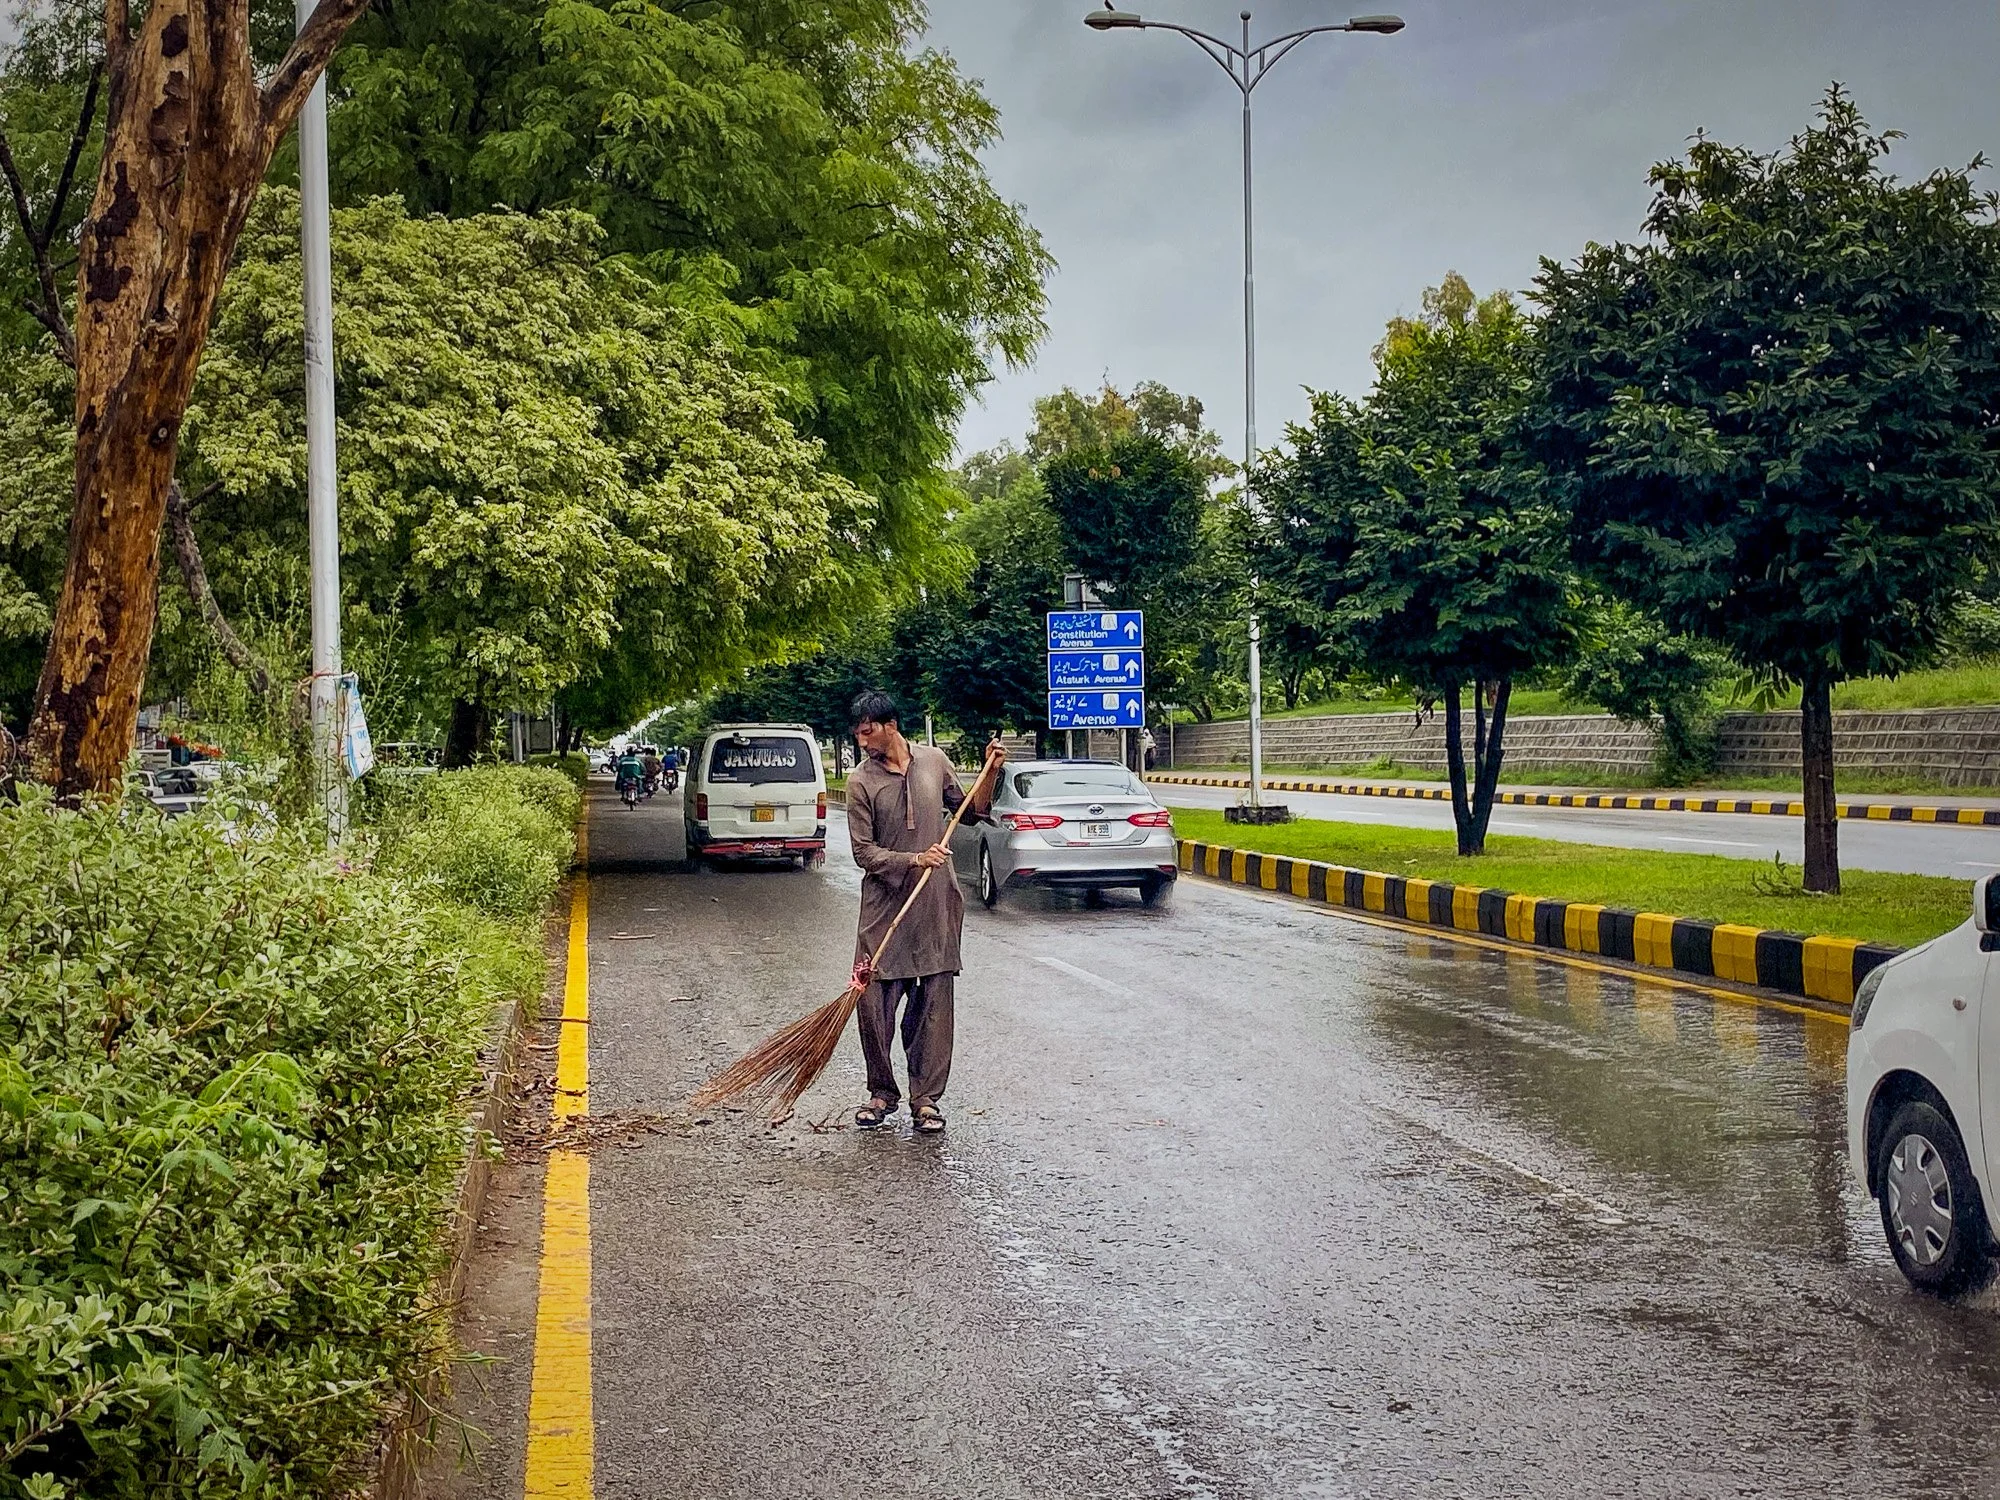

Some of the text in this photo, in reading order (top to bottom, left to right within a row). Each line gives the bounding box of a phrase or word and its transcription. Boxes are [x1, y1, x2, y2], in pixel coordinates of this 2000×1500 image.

[1051, 630, 1108, 640] Constitution
[1060, 639, 1094, 648] Avenue
[1056, 674, 1127, 685] Ataturk Avenue
[1053, 713, 1117, 726] 7th Avenue
